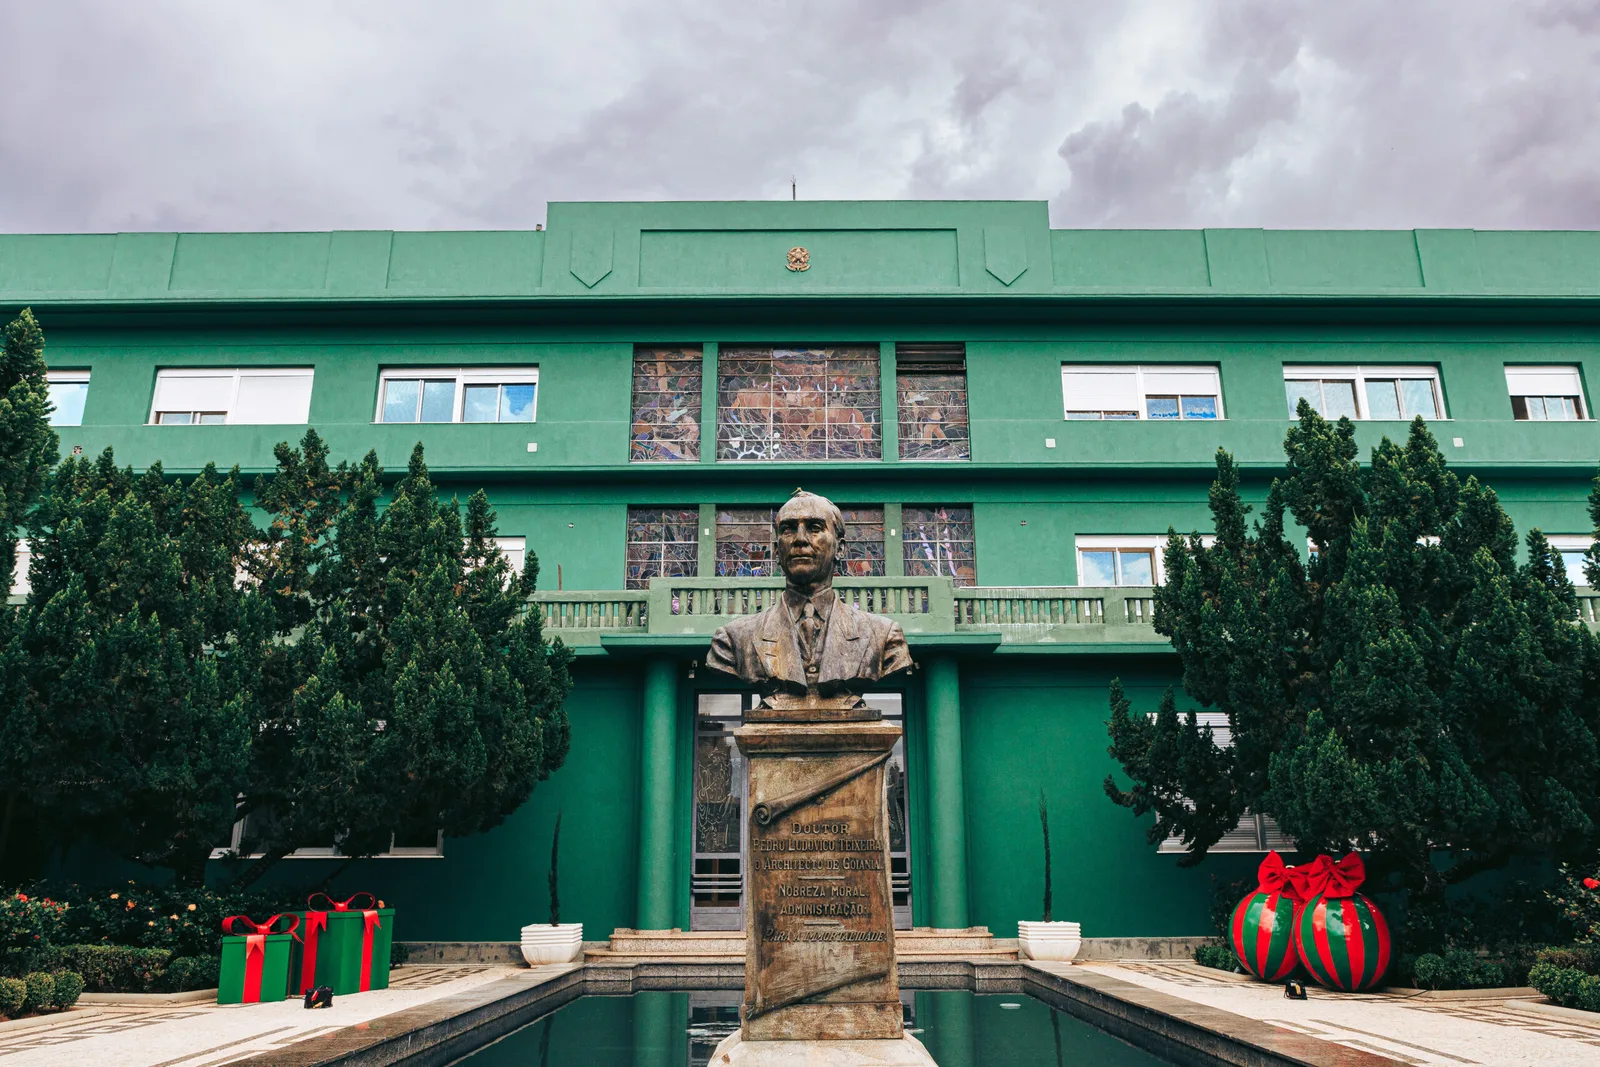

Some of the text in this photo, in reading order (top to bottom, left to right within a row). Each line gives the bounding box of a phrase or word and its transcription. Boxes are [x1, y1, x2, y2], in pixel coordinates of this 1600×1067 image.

[792, 822, 849, 834] DOUTOR
[753, 838, 785, 851] PEDRO
[788, 839, 835, 851] LUDOVICO
[764, 857, 823, 870] ARCHITECTO
[826, 860, 839, 870] DE
[778, 884, 826, 897] NOBREZA
